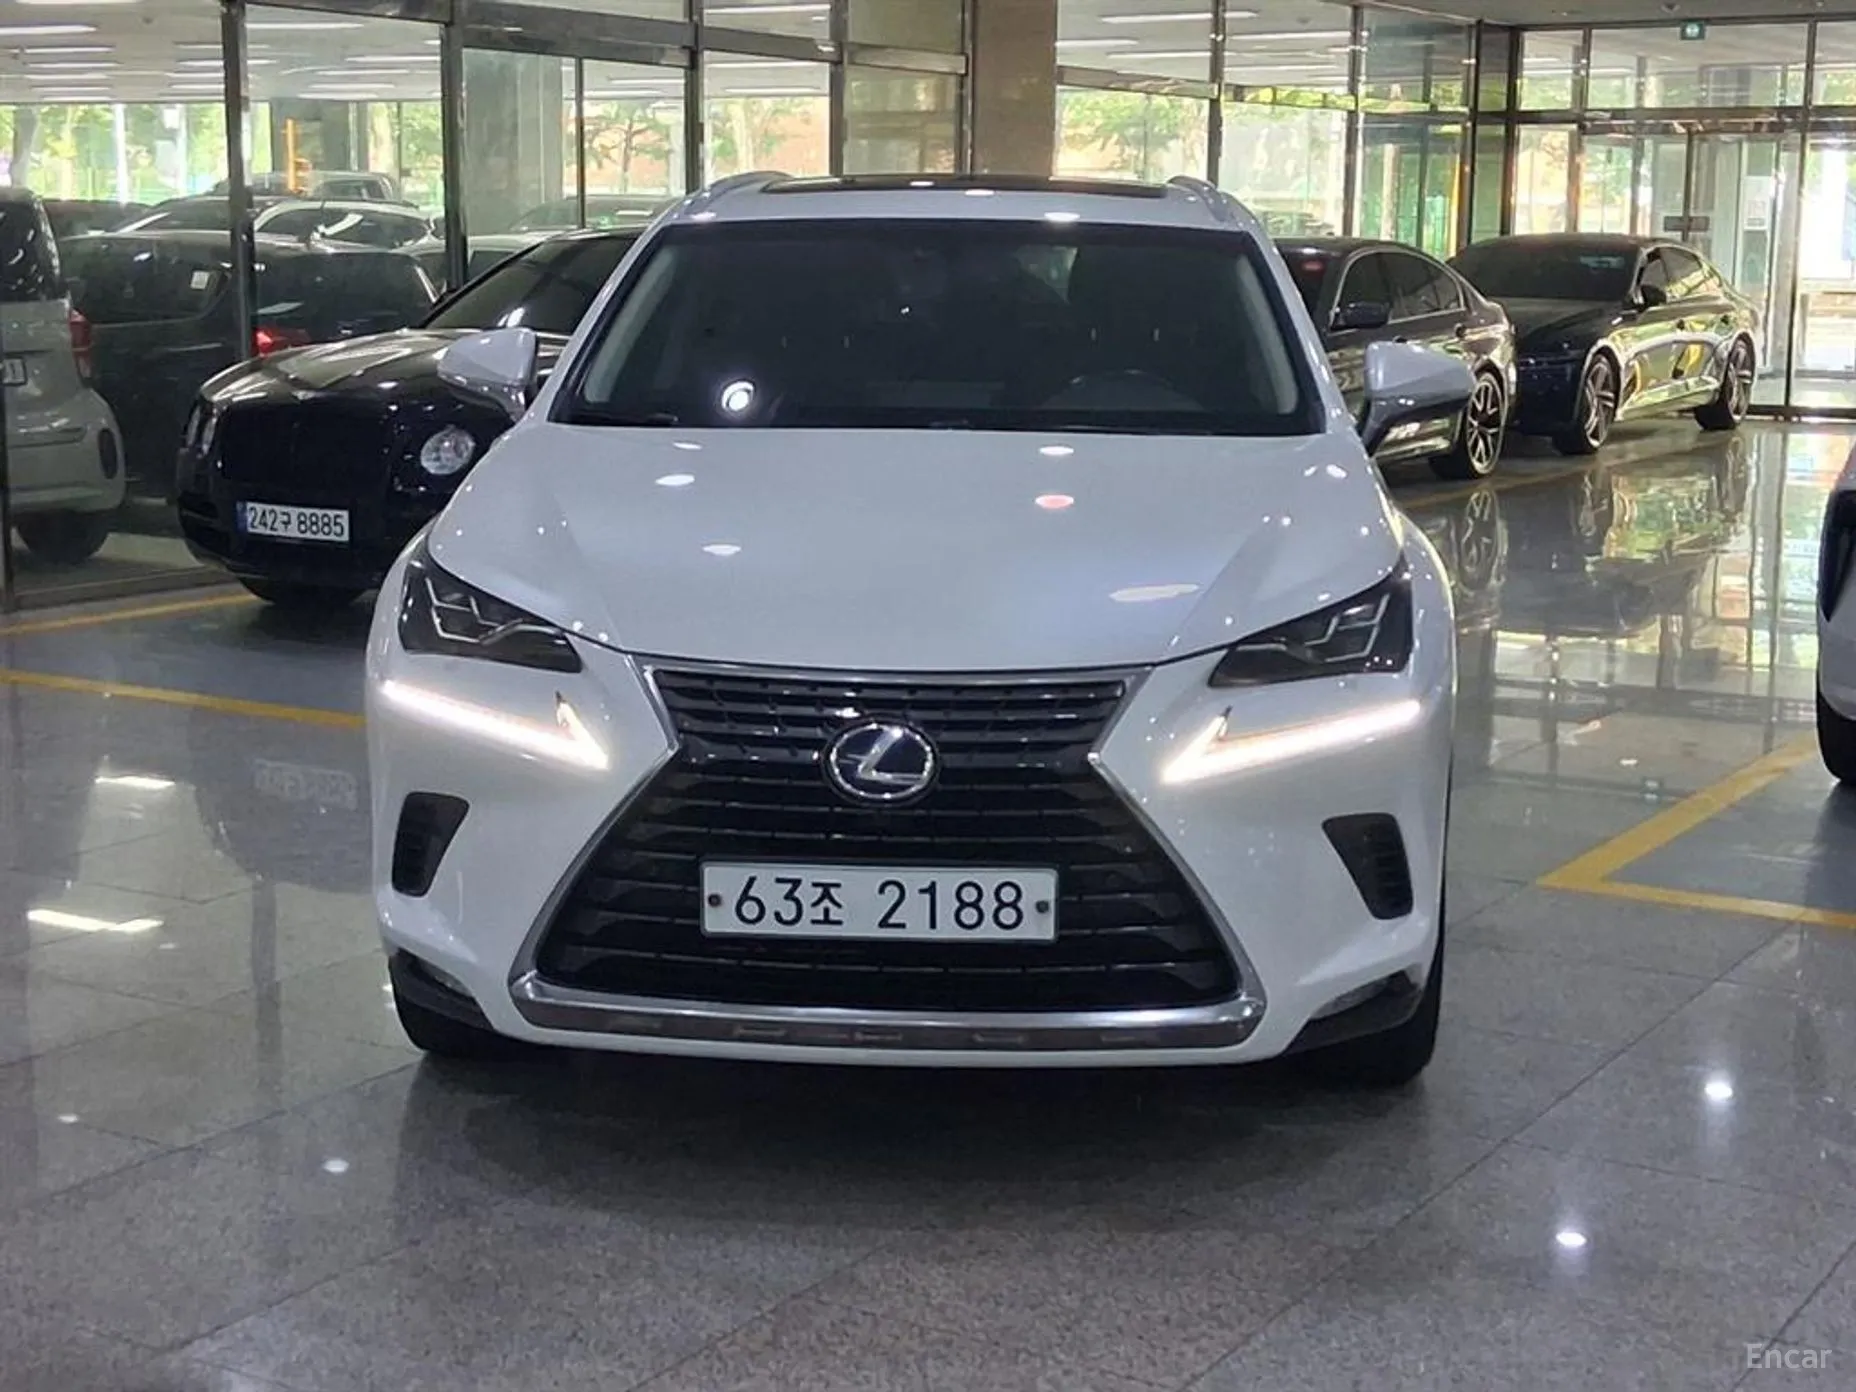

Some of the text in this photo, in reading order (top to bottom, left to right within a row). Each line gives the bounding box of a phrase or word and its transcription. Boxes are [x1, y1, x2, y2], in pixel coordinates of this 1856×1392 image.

[249, 506, 344, 537] 242구 8885
[734, 876, 1024, 930] 63조 2188
